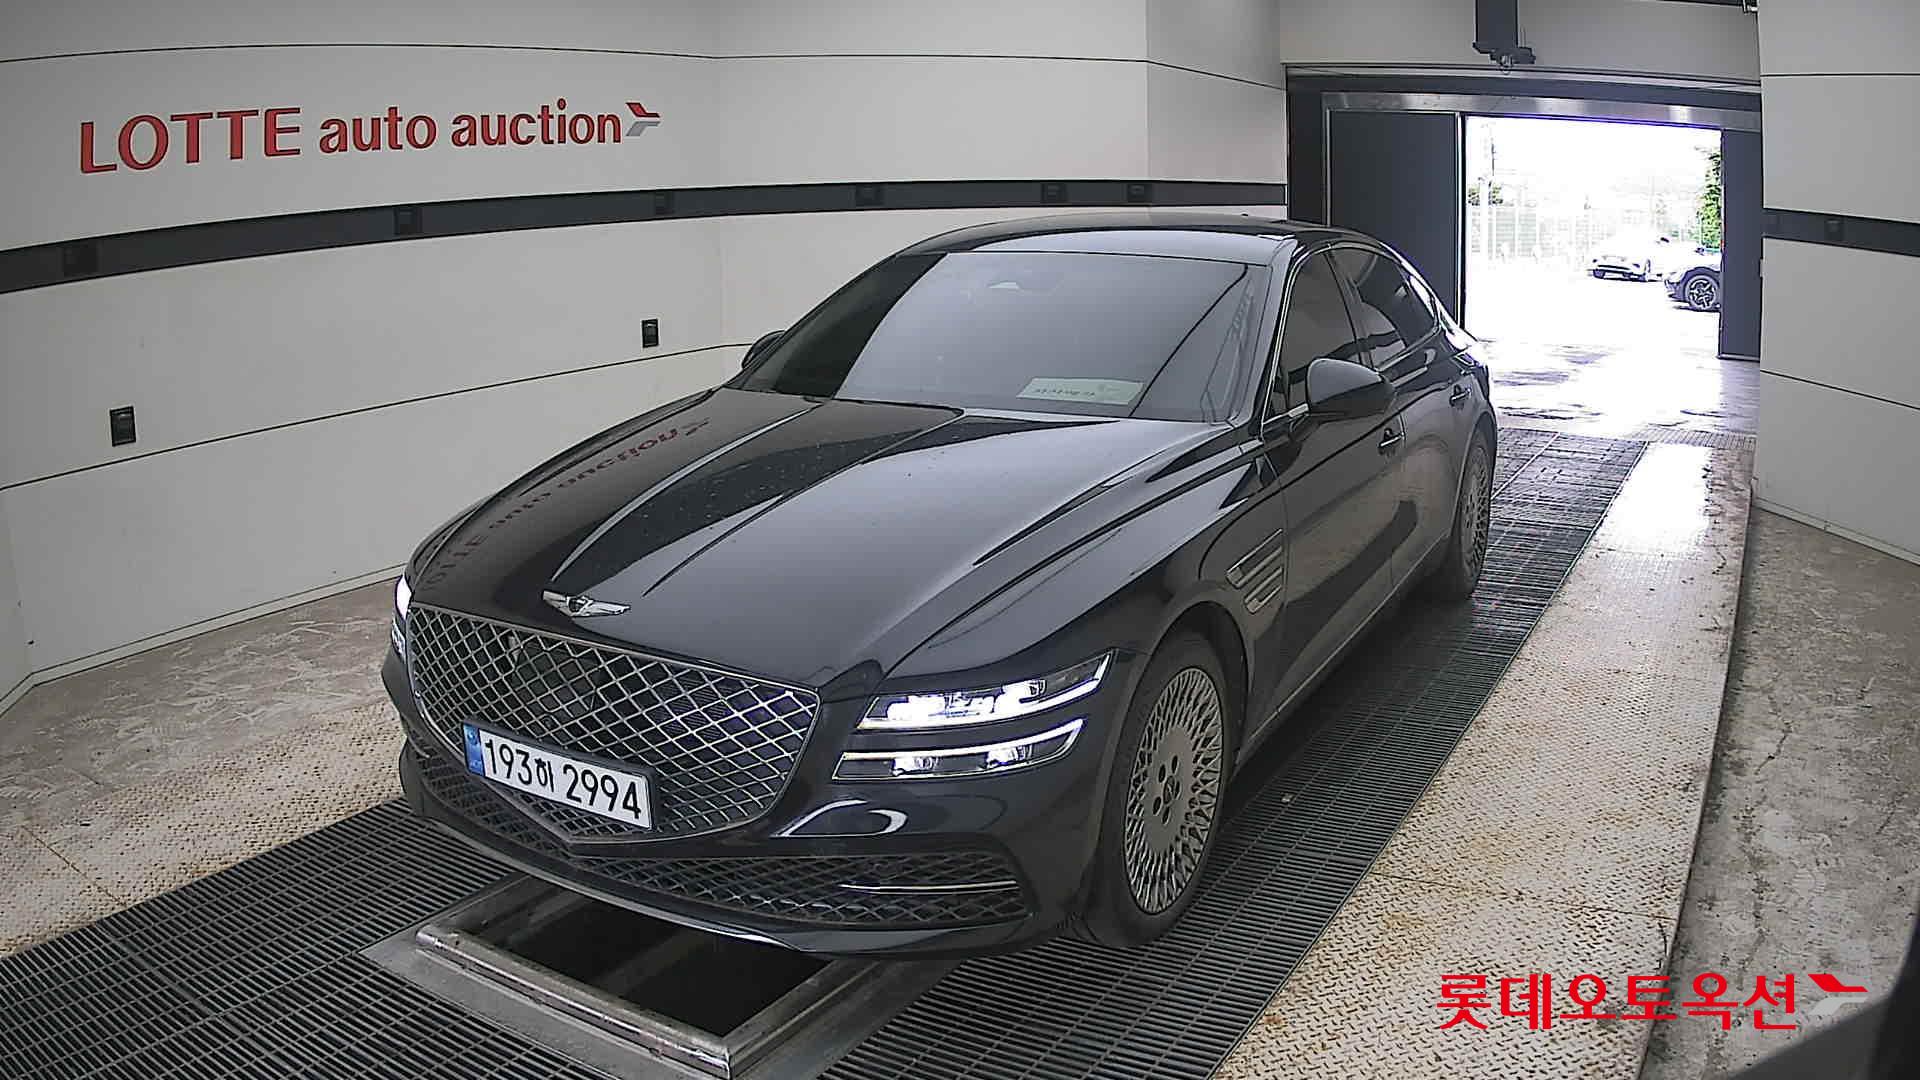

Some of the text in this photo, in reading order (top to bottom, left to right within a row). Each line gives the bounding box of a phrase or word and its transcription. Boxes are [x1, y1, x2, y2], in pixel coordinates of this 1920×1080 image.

[78, 97, 622, 175] LOTTE auto auction
[563, 764, 642, 820] 2994
